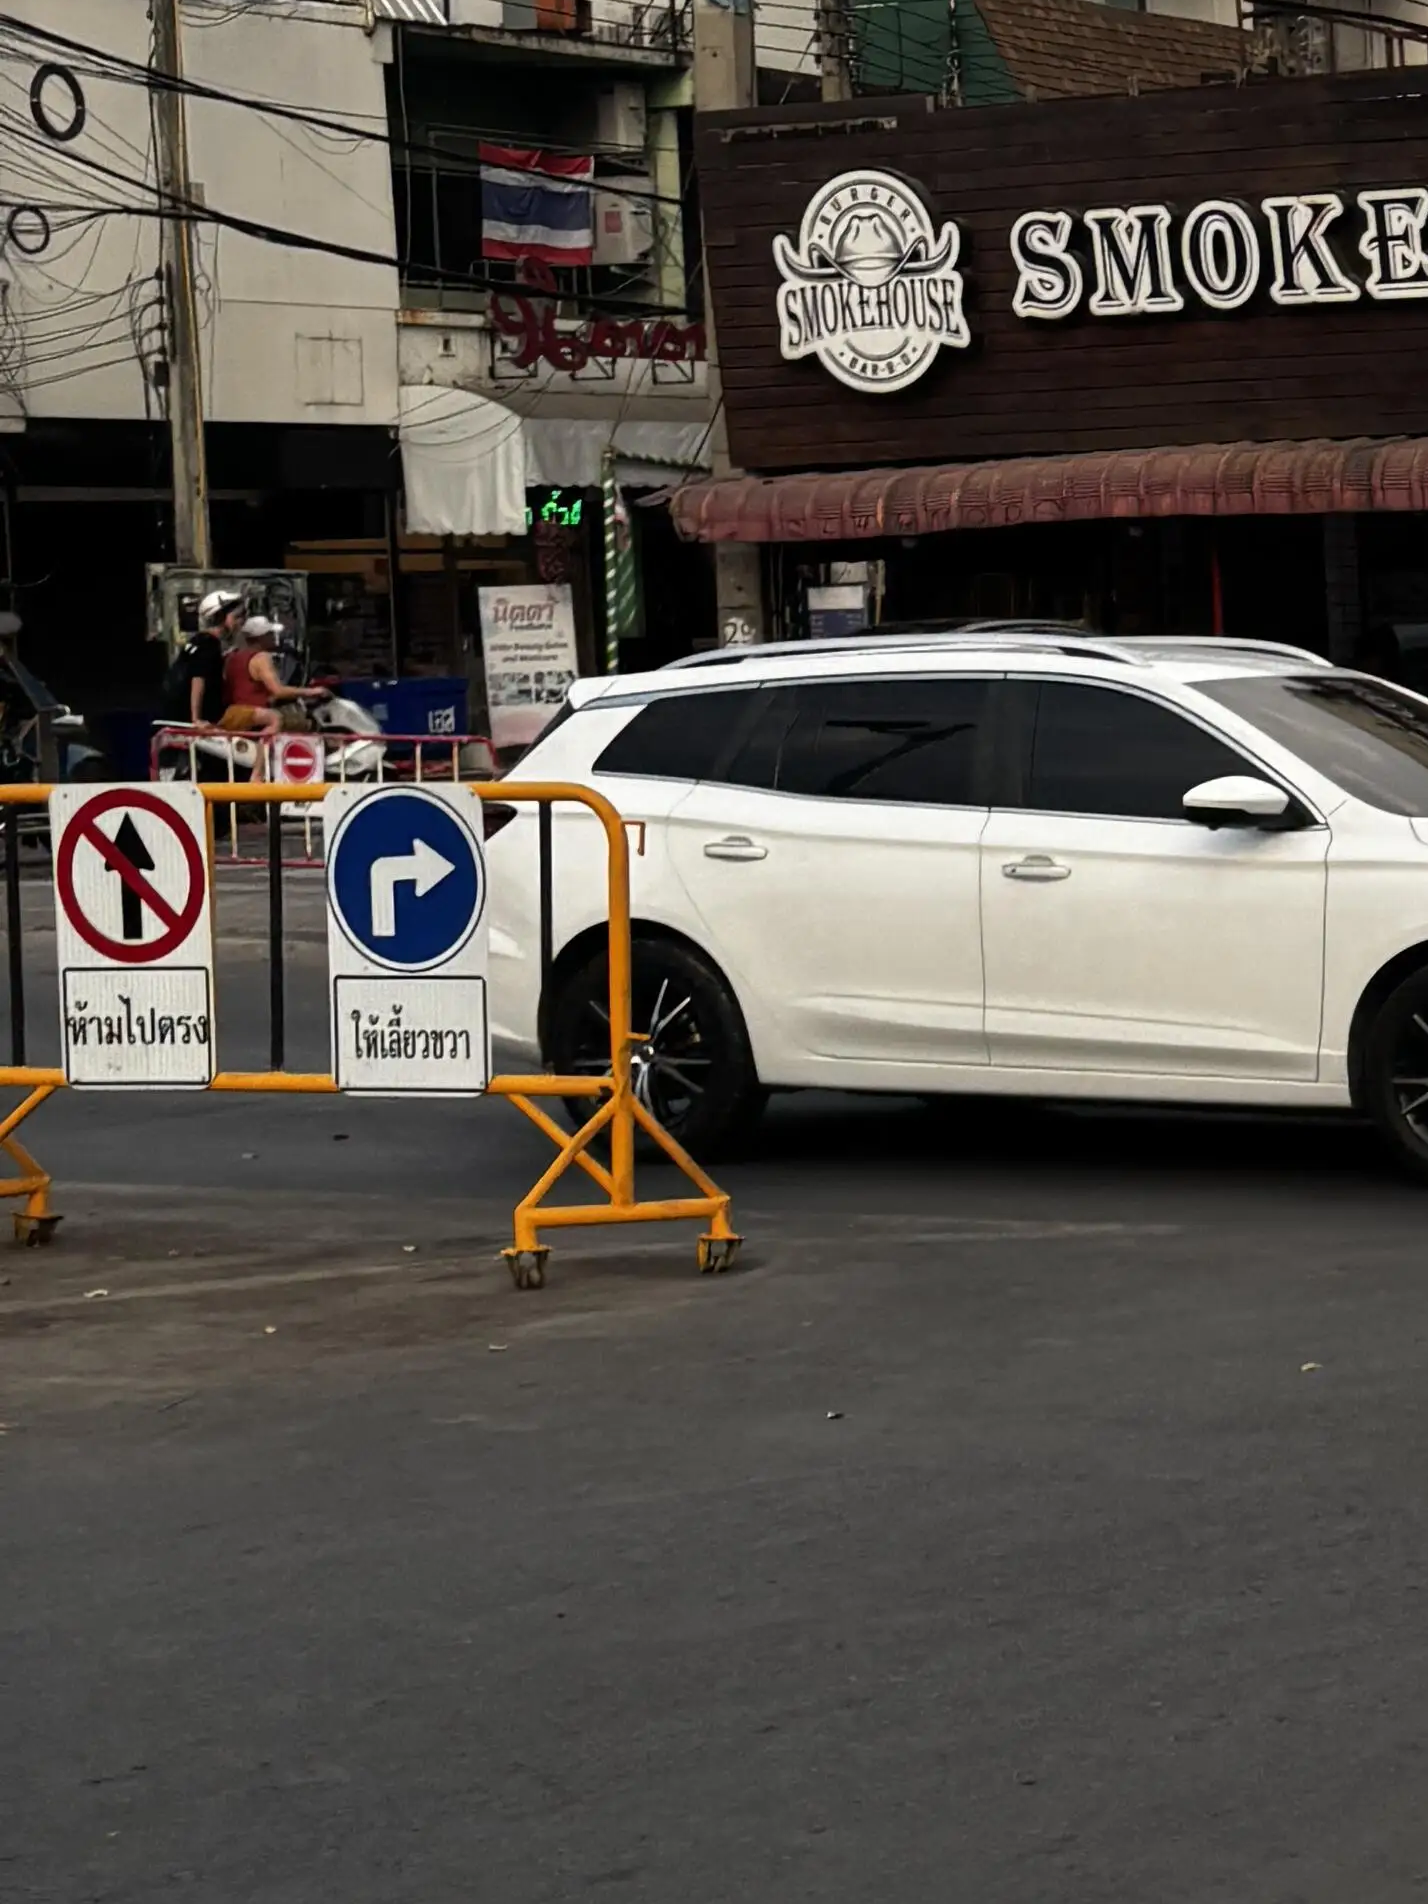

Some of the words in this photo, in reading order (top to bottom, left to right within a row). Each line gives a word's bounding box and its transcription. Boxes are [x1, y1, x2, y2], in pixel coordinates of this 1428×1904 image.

[820, 187, 912, 226] BURGER
[784, 277, 961, 347] SMOKEHOUSE
[67, 994, 208, 1046] ห้ามไปตรง
[350, 1003, 471, 1060] ให้เลี้ยวขวา
